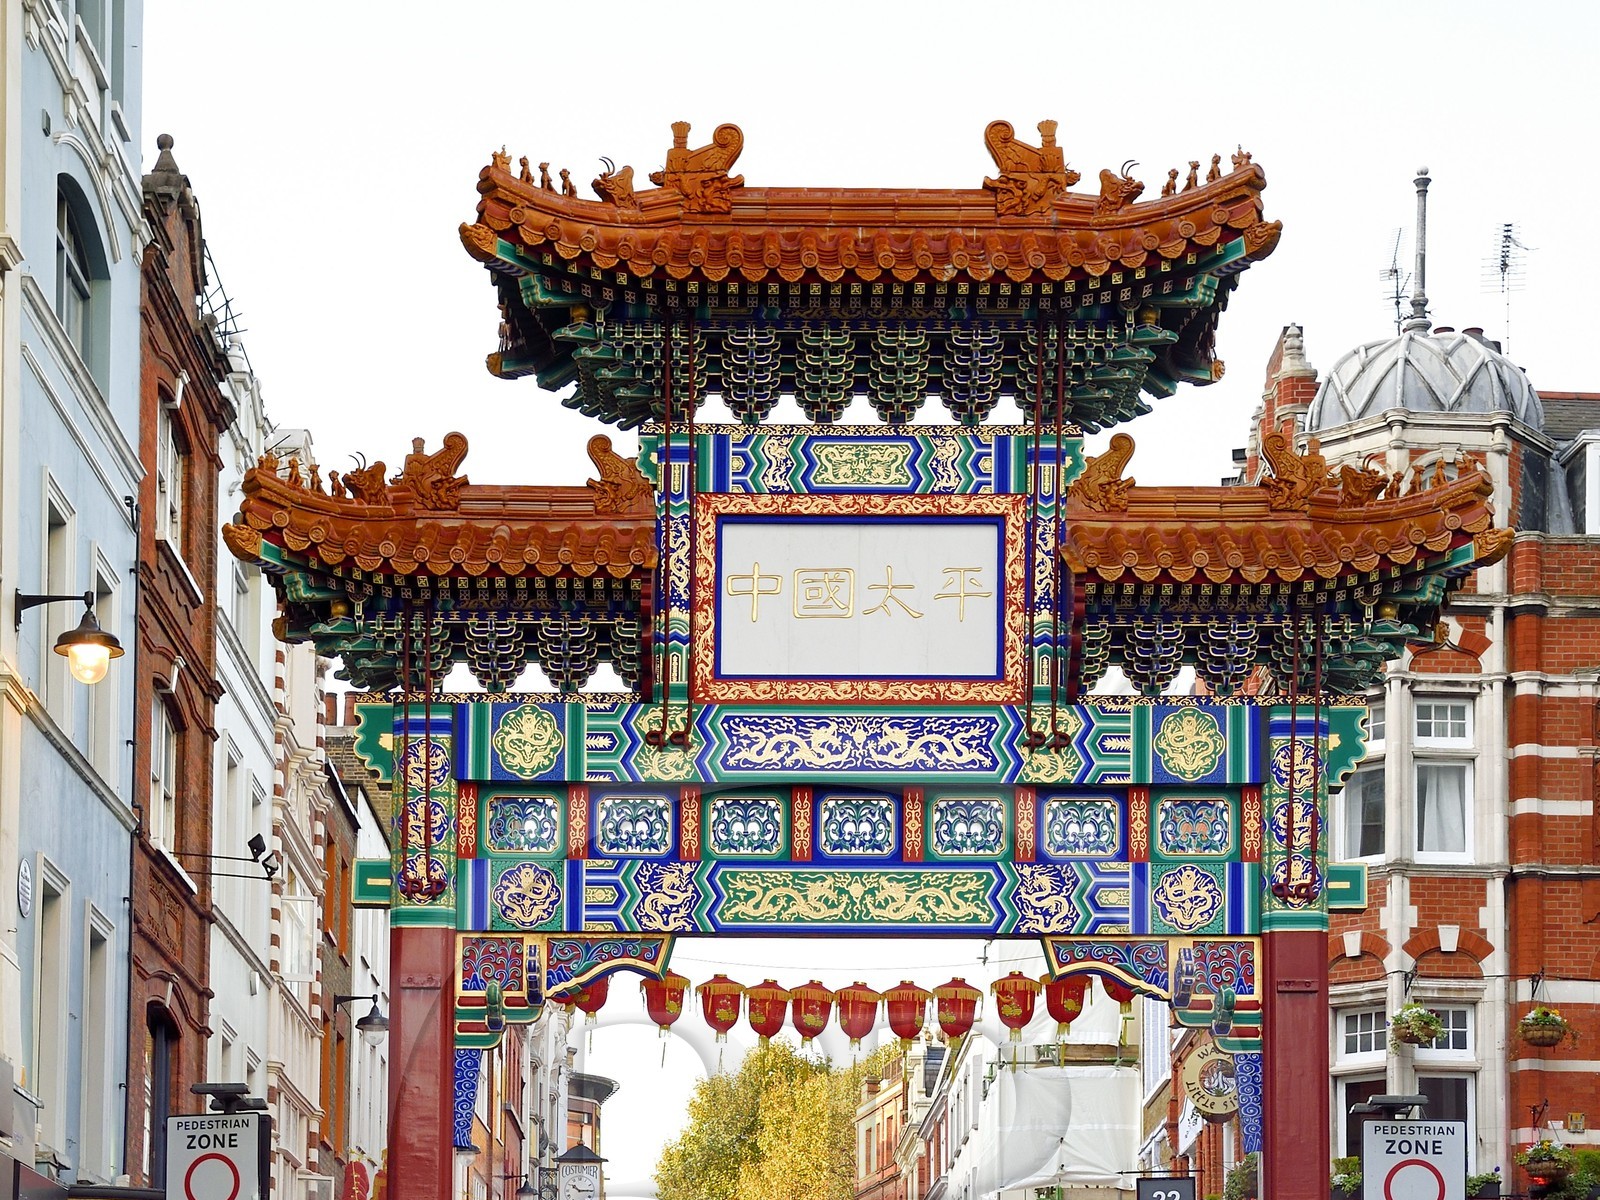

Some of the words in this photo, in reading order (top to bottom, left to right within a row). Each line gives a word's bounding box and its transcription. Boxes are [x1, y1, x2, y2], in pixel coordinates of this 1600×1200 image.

[726, 561, 993, 623] 中國太平
[177, 1118, 250, 1131] PEDESTRIAN
[1374, 1125, 1455, 1136] PEDESTRIAN
[186, 1133, 238, 1150] ZONE
[1385, 1139, 1443, 1155] ZONE
[561, 1165, 598, 1180] COSTUMIER
